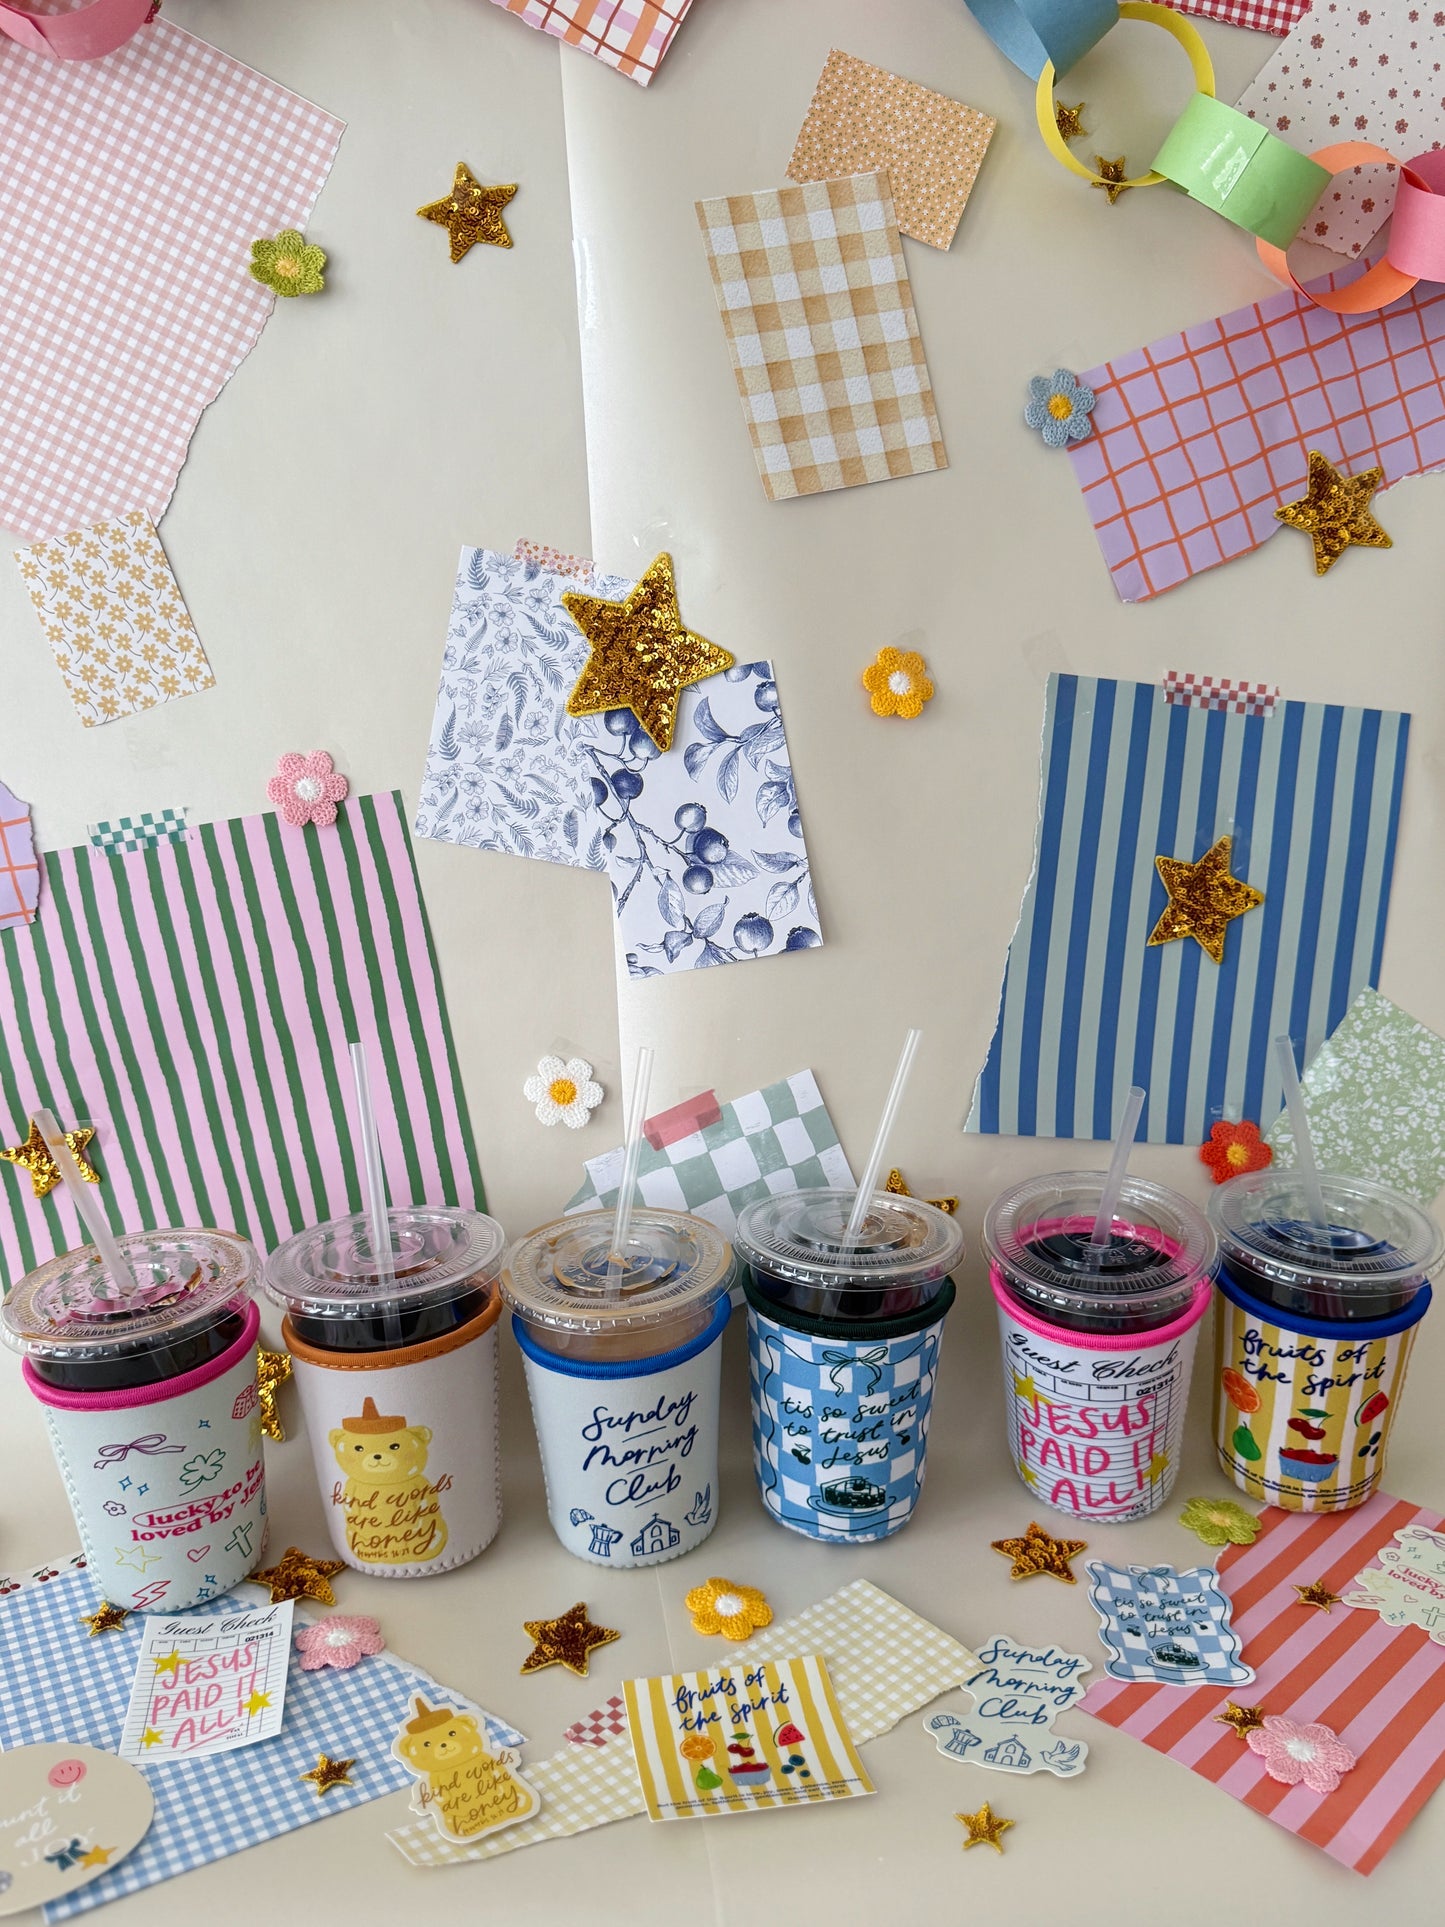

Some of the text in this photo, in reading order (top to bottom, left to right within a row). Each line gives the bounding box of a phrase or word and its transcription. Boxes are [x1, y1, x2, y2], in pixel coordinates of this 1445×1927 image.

[1008, 1331, 1180, 1381] Guest Check
[1239, 1329, 1373, 1367] fruits of
[1136, 1375, 1175, 1396] 021314
[1239, 1359, 1292, 1384] the
[582, 1391, 698, 1441] Sunday
[781, 1380, 921, 1422] tis so sweet
[1022, 1394, 1156, 1438] JESUS
[784, 1409, 916, 1444] to trust in
[582, 1424, 699, 1471] Morning
[1019, 1423, 1110, 1475] PAID
[1133, 1423, 1166, 1468] IT
[331, 1473, 453, 1510] kind words
[606, 1463, 681, 1505] Club
[131, 1518, 203, 1541] loved
[208, 1502, 235, 1523] by
[147, 1496, 218, 1526] lucky
[222, 1482, 242, 1500] to
[347, 1502, 440, 1529] are like
[352, 1519, 436, 1555] honey
[1388, 1569, 1428, 1591] loved
[1403, 1568, 1441, 1589] lucky
[1112, 1592, 1206, 1610] tis so sweet
[1117, 1608, 1208, 1622] to trust in
[158, 1606, 278, 1636] Guest Check
[245, 1631, 274, 1643] 021314
[162, 1642, 258, 1690] JESUS
[979, 1639, 1084, 1679] Sunday
[151, 1667, 266, 1726] PAID IT
[671, 1666, 766, 1714] fruits of
[967, 1668, 1077, 1706] Morning
[679, 1710, 722, 1731] the
[978, 1697, 1049, 1725] Club
[58, 1781, 82, 1804] it
[418, 1750, 514, 1809] kind words
[442, 1771, 511, 1812] are like
[452, 1785, 519, 1835] honey
[15, 1817, 58, 1848] all
